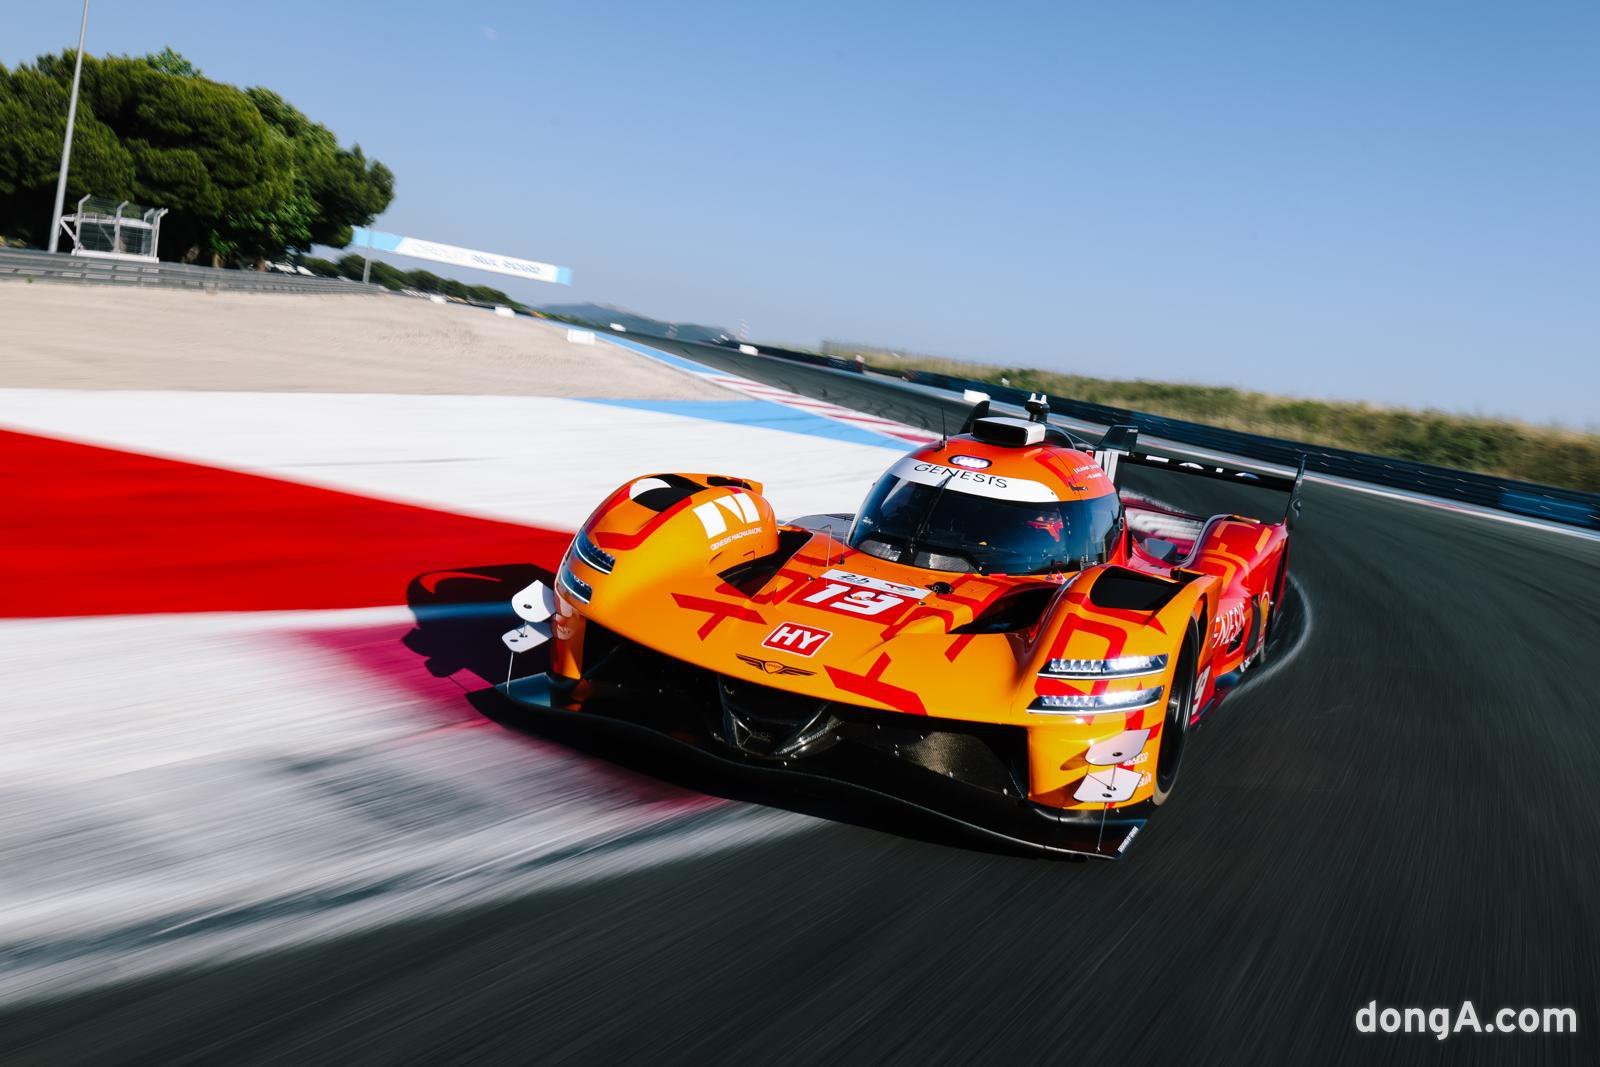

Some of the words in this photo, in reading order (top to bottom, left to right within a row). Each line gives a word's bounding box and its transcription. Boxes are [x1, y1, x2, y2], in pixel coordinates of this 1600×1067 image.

[914, 463, 1008, 489] GENESIS
[803, 583, 904, 616] 19
[770, 626, 826, 649] HY
